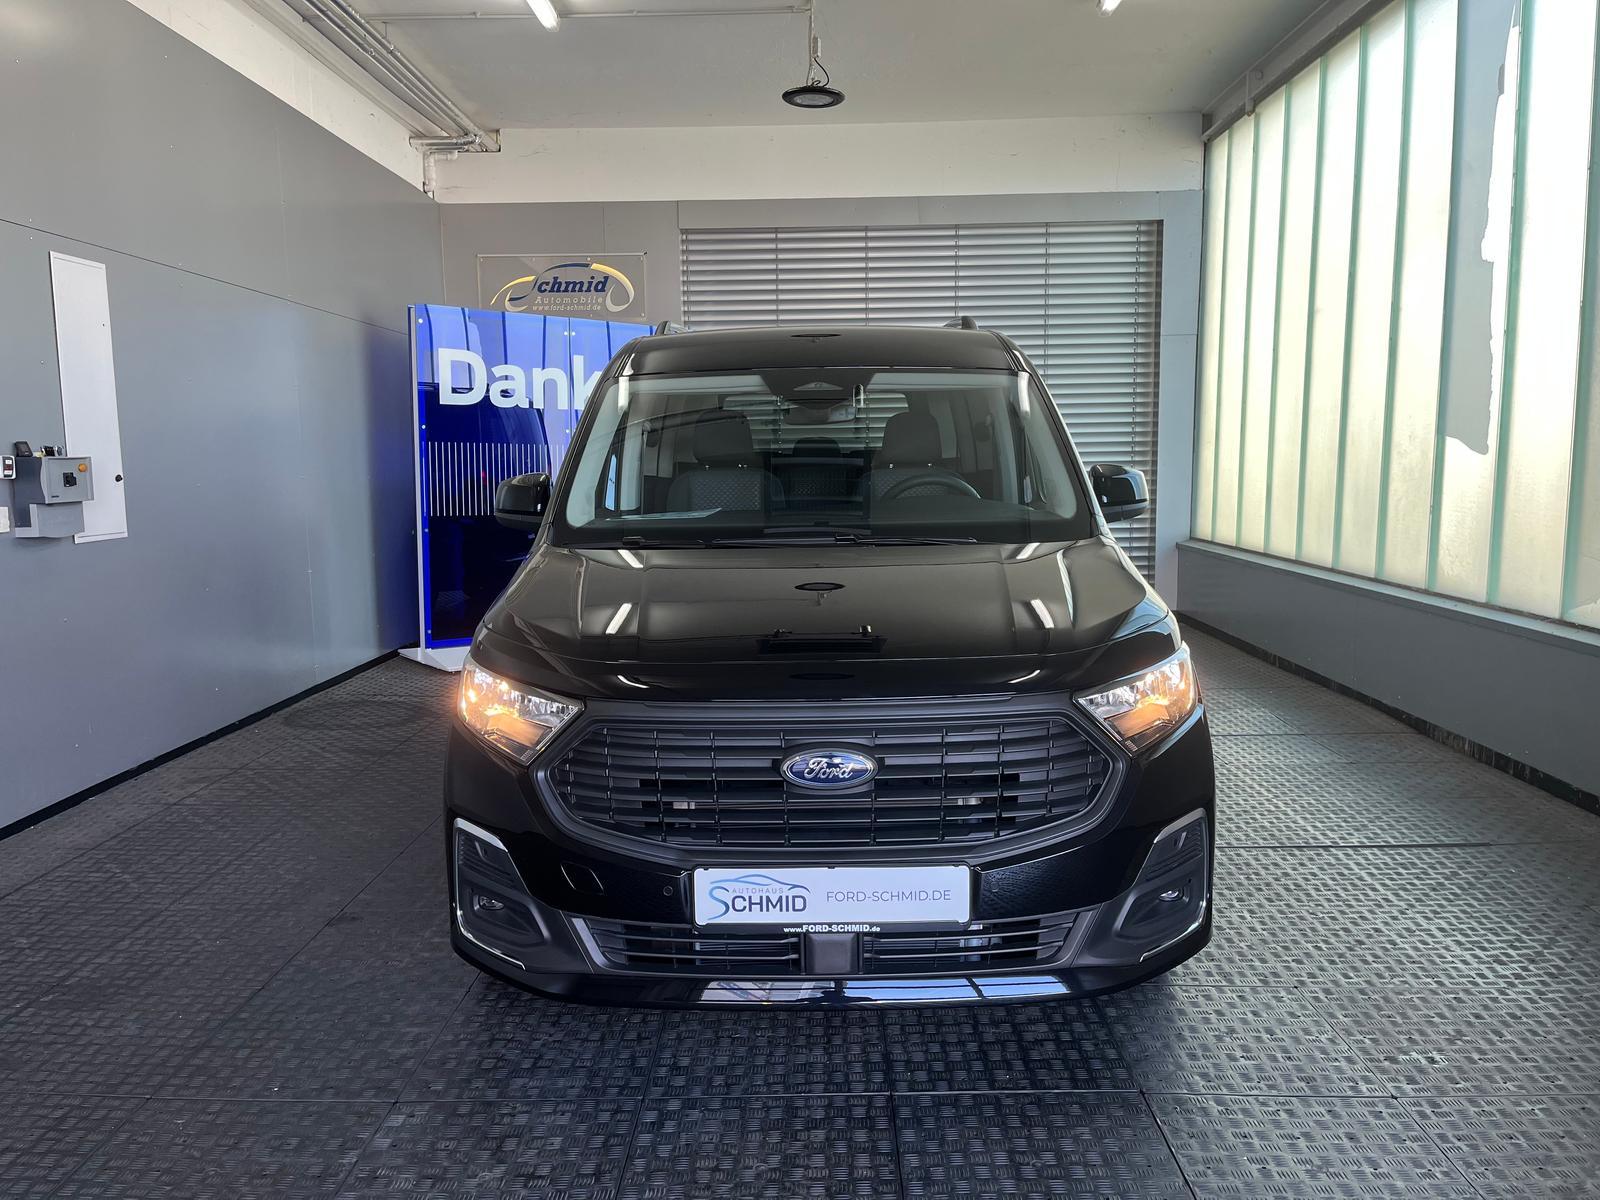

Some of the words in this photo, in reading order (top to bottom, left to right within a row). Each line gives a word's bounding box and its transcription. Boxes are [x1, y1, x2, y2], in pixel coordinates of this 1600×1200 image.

[534, 296, 603, 305] Automobile
[803, 757, 853, 779] Ford
[707, 885, 808, 921] SCHMID
[826, 889, 952, 903] FORD-SCHMID.DE
[783, 924, 881, 933] www.FORD-SCHMID.de
